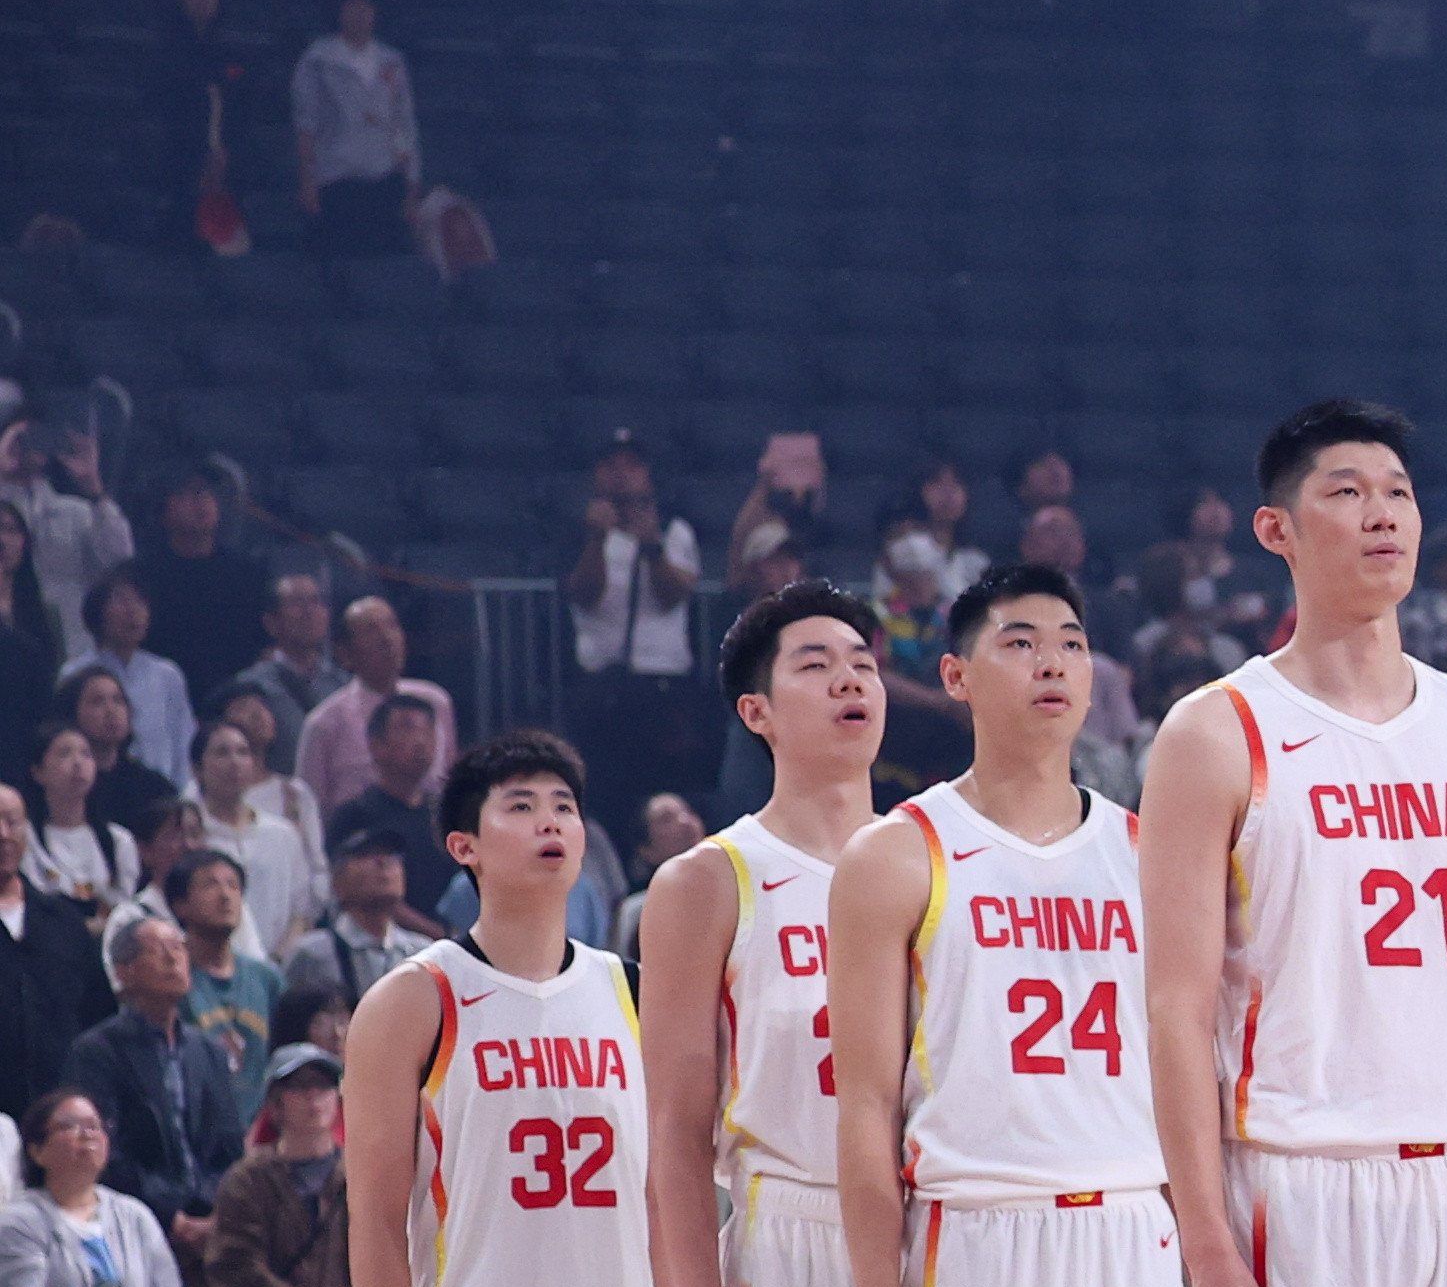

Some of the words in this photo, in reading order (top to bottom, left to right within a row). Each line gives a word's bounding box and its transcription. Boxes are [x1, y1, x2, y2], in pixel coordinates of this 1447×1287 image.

[970, 896, 1138, 953] CHINA
[473, 1037, 626, 1091] CHINA
[1007, 978, 1121, 1076] 24
[509, 1117, 617, 1209] 32
